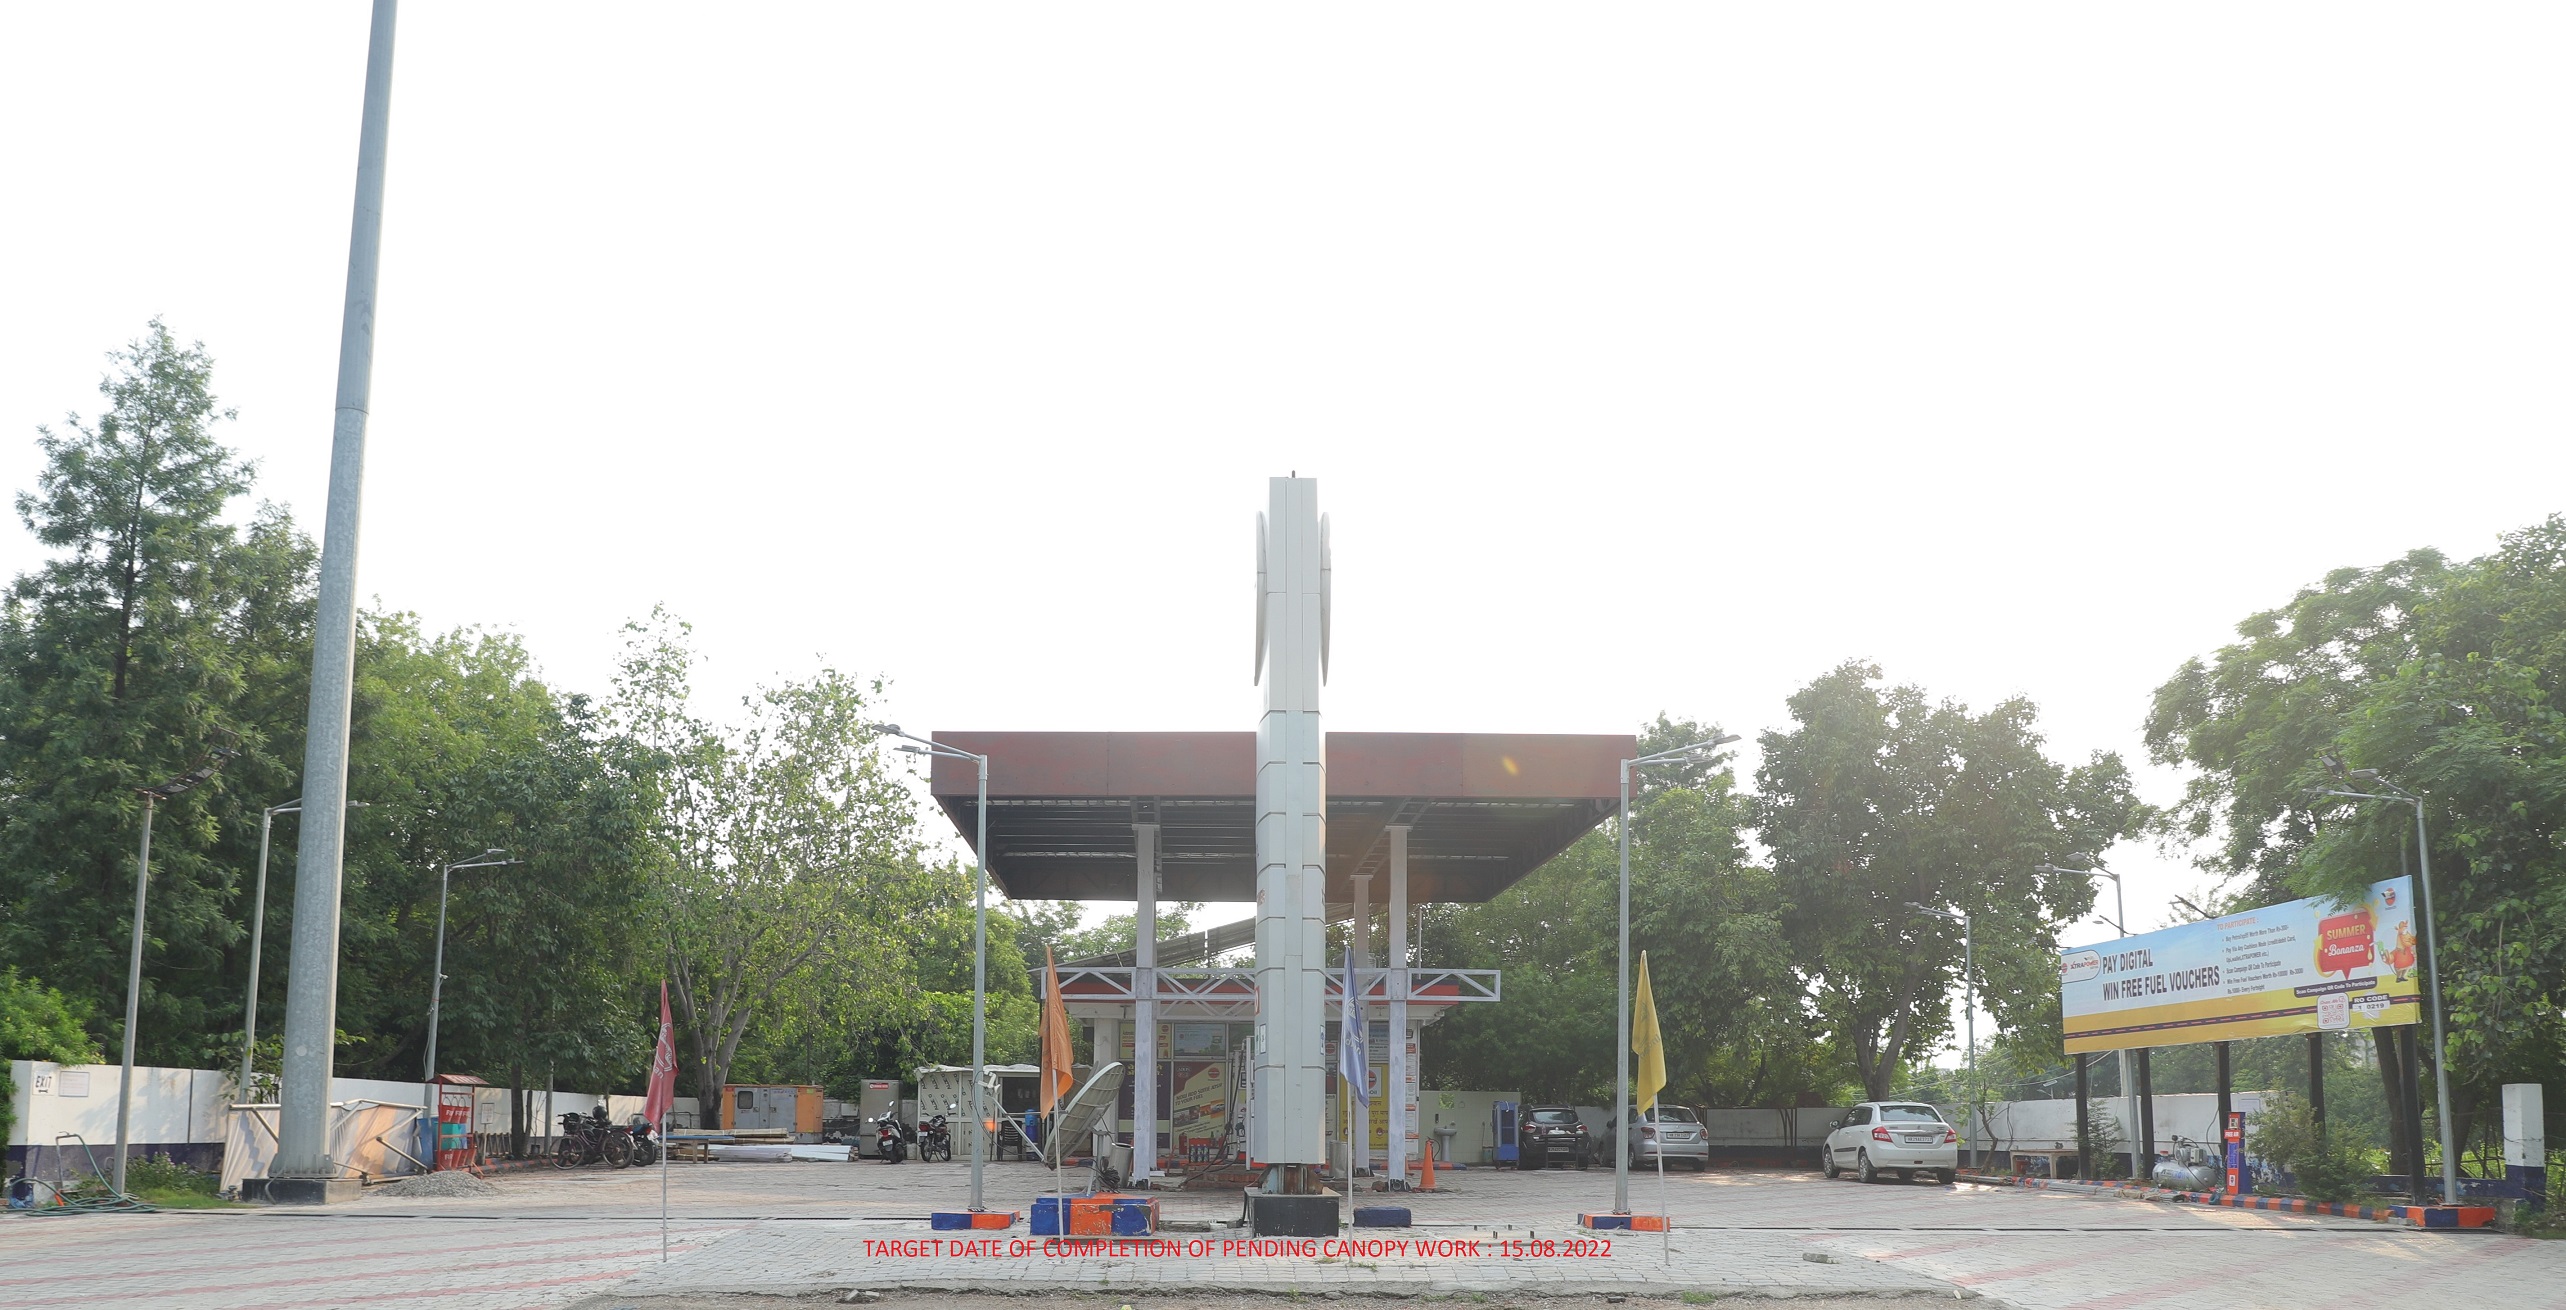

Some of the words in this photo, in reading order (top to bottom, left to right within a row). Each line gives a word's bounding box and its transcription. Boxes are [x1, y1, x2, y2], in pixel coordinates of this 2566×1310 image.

[2217, 922, 2224, 930] TO
[2225, 917, 2256, 929] PARTICIPATE
[2327, 924, 2366, 941] SUMMER
[2328, 944, 2365, 957] Bonanza
[2103, 954, 2118, 974] PAY
[2120, 948, 2153, 971] DIGITAL
[2103, 981, 2119, 1001] WIN
[2122, 978, 2142, 998] FREE
[2145, 974, 2167, 995] FUEL
[2169, 965, 2220, 992] VOUCHERS
[35, 1075, 52, 1088] EXIT
